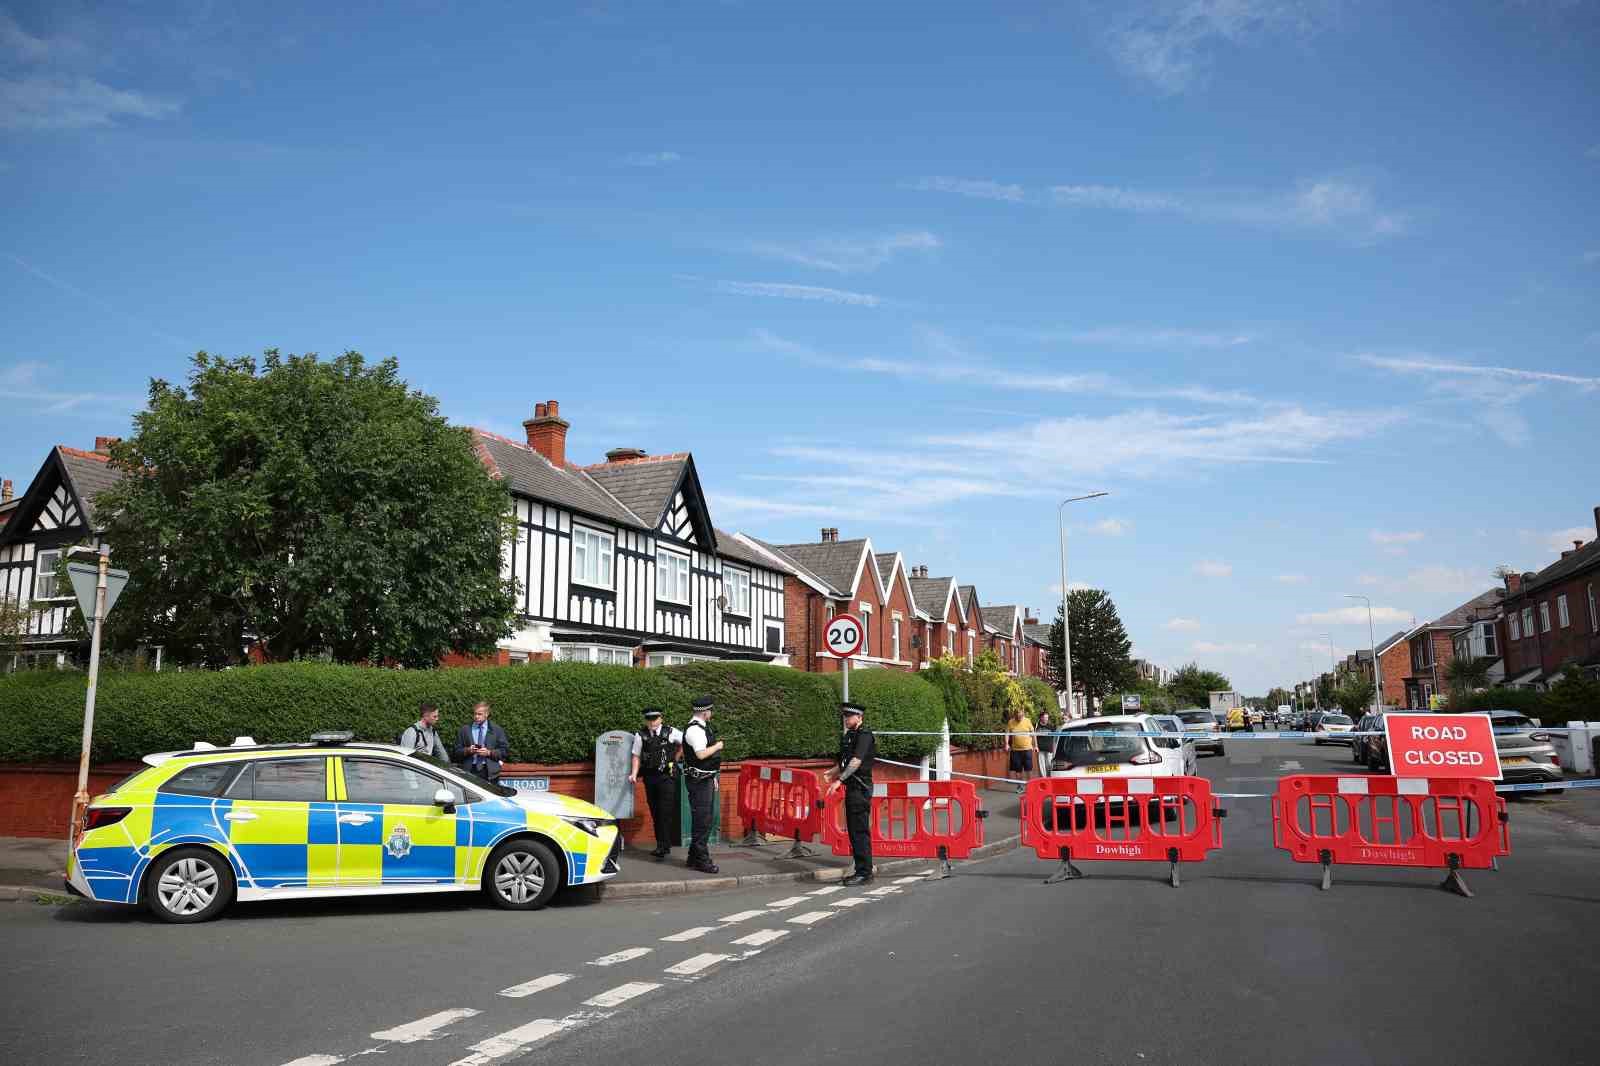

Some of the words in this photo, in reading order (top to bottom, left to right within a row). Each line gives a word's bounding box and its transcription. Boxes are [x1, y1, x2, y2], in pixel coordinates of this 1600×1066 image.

[830, 628, 857, 645] 20
[1411, 726, 1467, 740] ROAD
[1404, 750, 1484, 765] CLOSED
[513, 780, 545, 791] ROAD
[1095, 845, 1142, 857] Dowhigh
